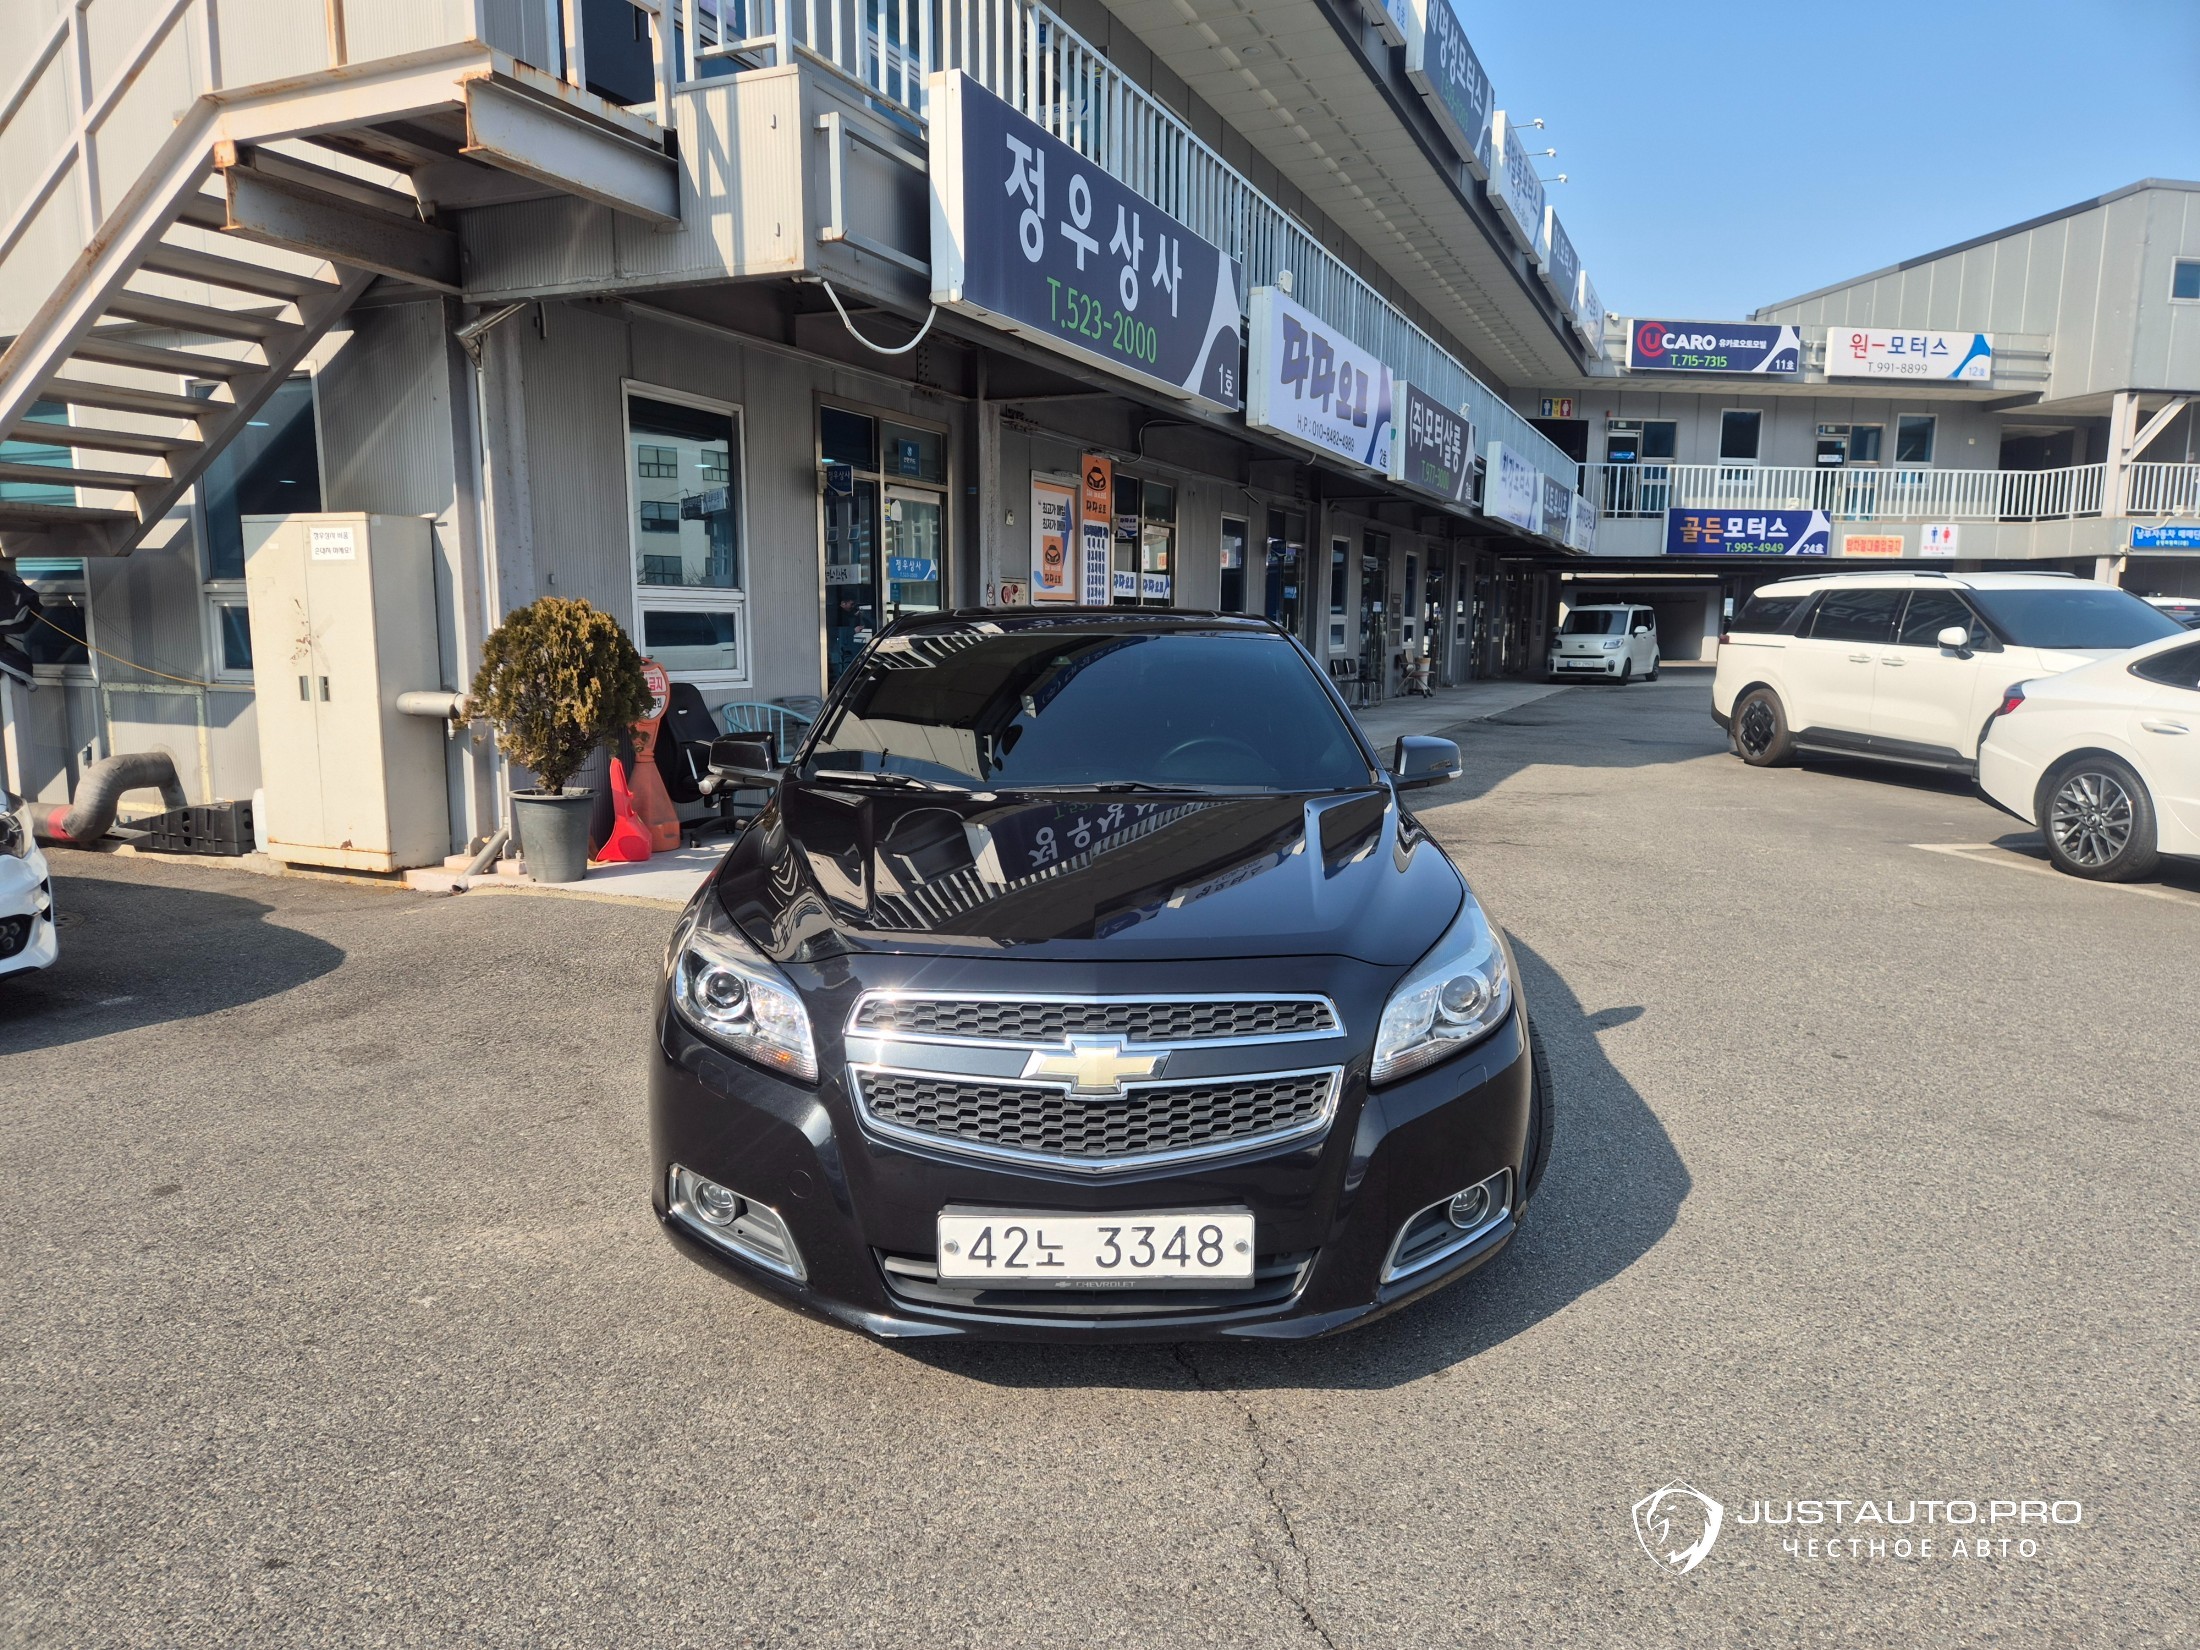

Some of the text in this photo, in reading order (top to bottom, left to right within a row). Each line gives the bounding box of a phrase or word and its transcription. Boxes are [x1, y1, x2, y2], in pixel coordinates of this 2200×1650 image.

[1005, 133, 1182, 318] 정우상사
[1047, 276, 1157, 364] T.523-2000
[1670, 354, 1728, 368] T.715-7315
[1775, 359, 1795, 371] 11호
[1867, 362, 1928, 375] T.991-8899
[1968, 366, 1985, 377] 12호
[1218, 363, 1234, 397] 1호
[1410, 396, 1461, 474] (주)모터살롱
[1379, 448, 1387, 468] 2호
[1680, 517, 1789, 543] 골든모터스
[1725, 542, 1784, 553] T.995-4949
[1802, 543, 1825, 554] 24호
[895, 559, 922, 572] 정우상사
[967, 1224, 1224, 1269] 42노 3348
[1076, 1281, 1136, 1289] CHEVROLET
